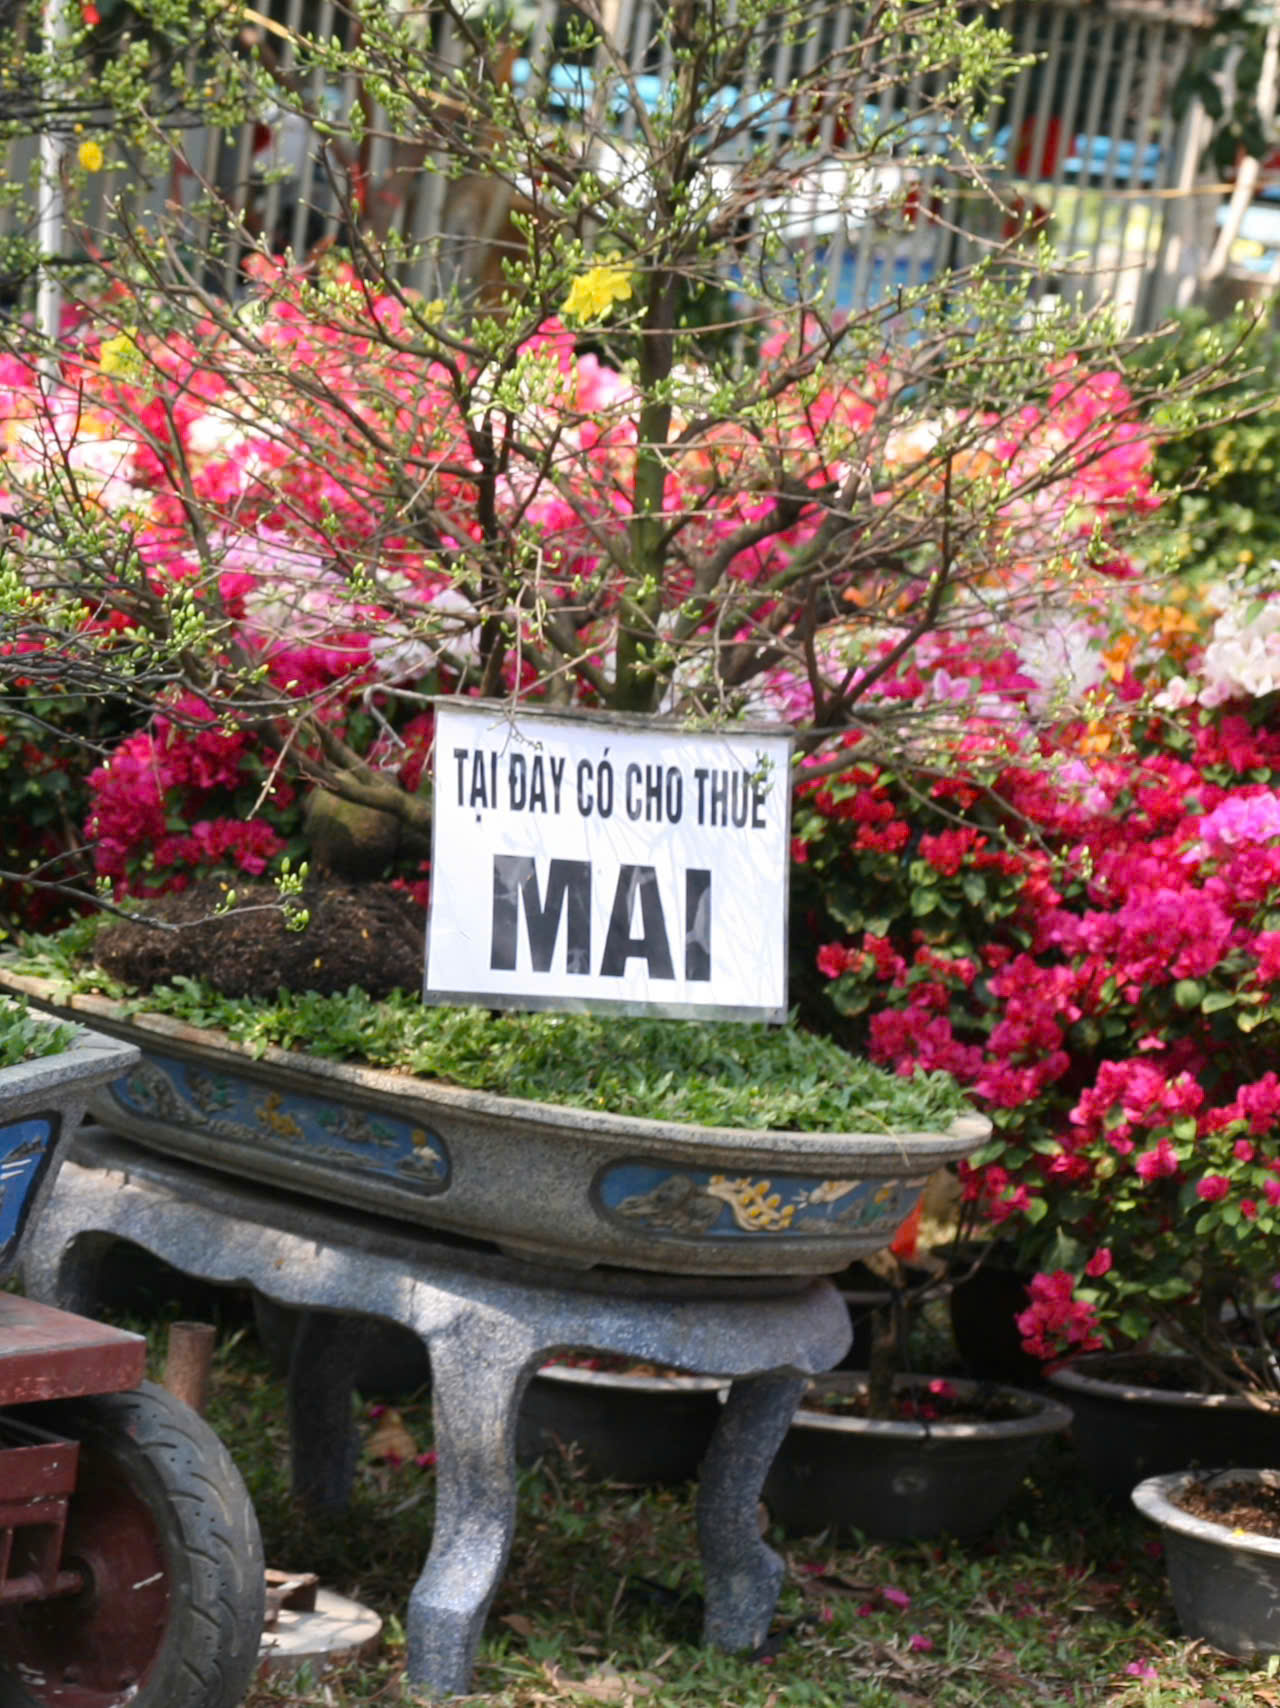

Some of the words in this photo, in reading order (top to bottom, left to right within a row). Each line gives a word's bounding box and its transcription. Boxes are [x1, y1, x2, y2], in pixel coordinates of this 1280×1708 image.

[453, 748, 498, 822] TẠI
[576, 748, 614, 818] CÓ
[625, 762, 683, 825] CHO
[490, 854, 712, 982] MAI
